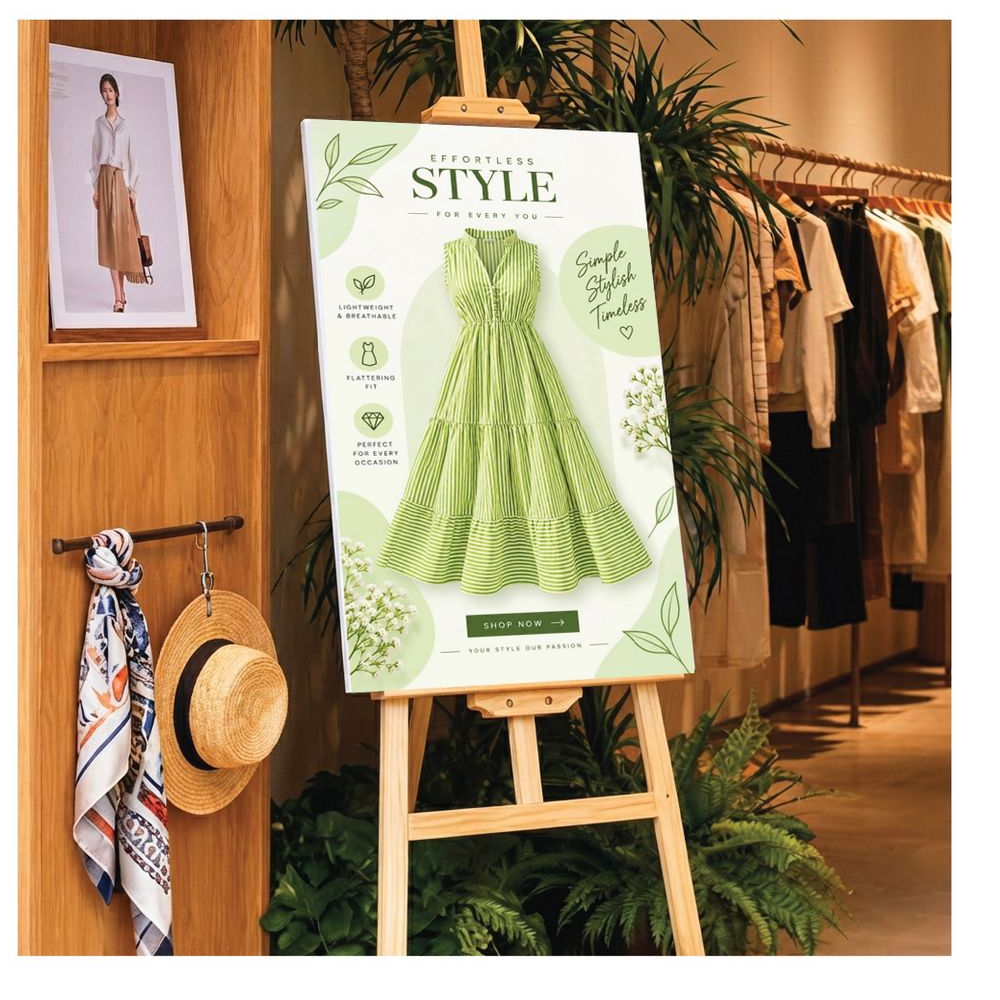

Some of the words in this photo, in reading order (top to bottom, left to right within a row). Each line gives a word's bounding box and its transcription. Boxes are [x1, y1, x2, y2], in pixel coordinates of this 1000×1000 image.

[430, 154, 534, 166] EFFORTLESS
[412, 166, 557, 203] STYLE
[468, 211, 506, 219] EVERY
[575, 239, 627, 278] Simple
[586, 262, 637, 302] Stylish
[589, 293, 647, 330] Timeless
[483, 621, 513, 630] SHOP
[518, 619, 543, 628] NOW
[468, 647, 491, 655] YOUR
[546, 642, 582, 650] PASSION
